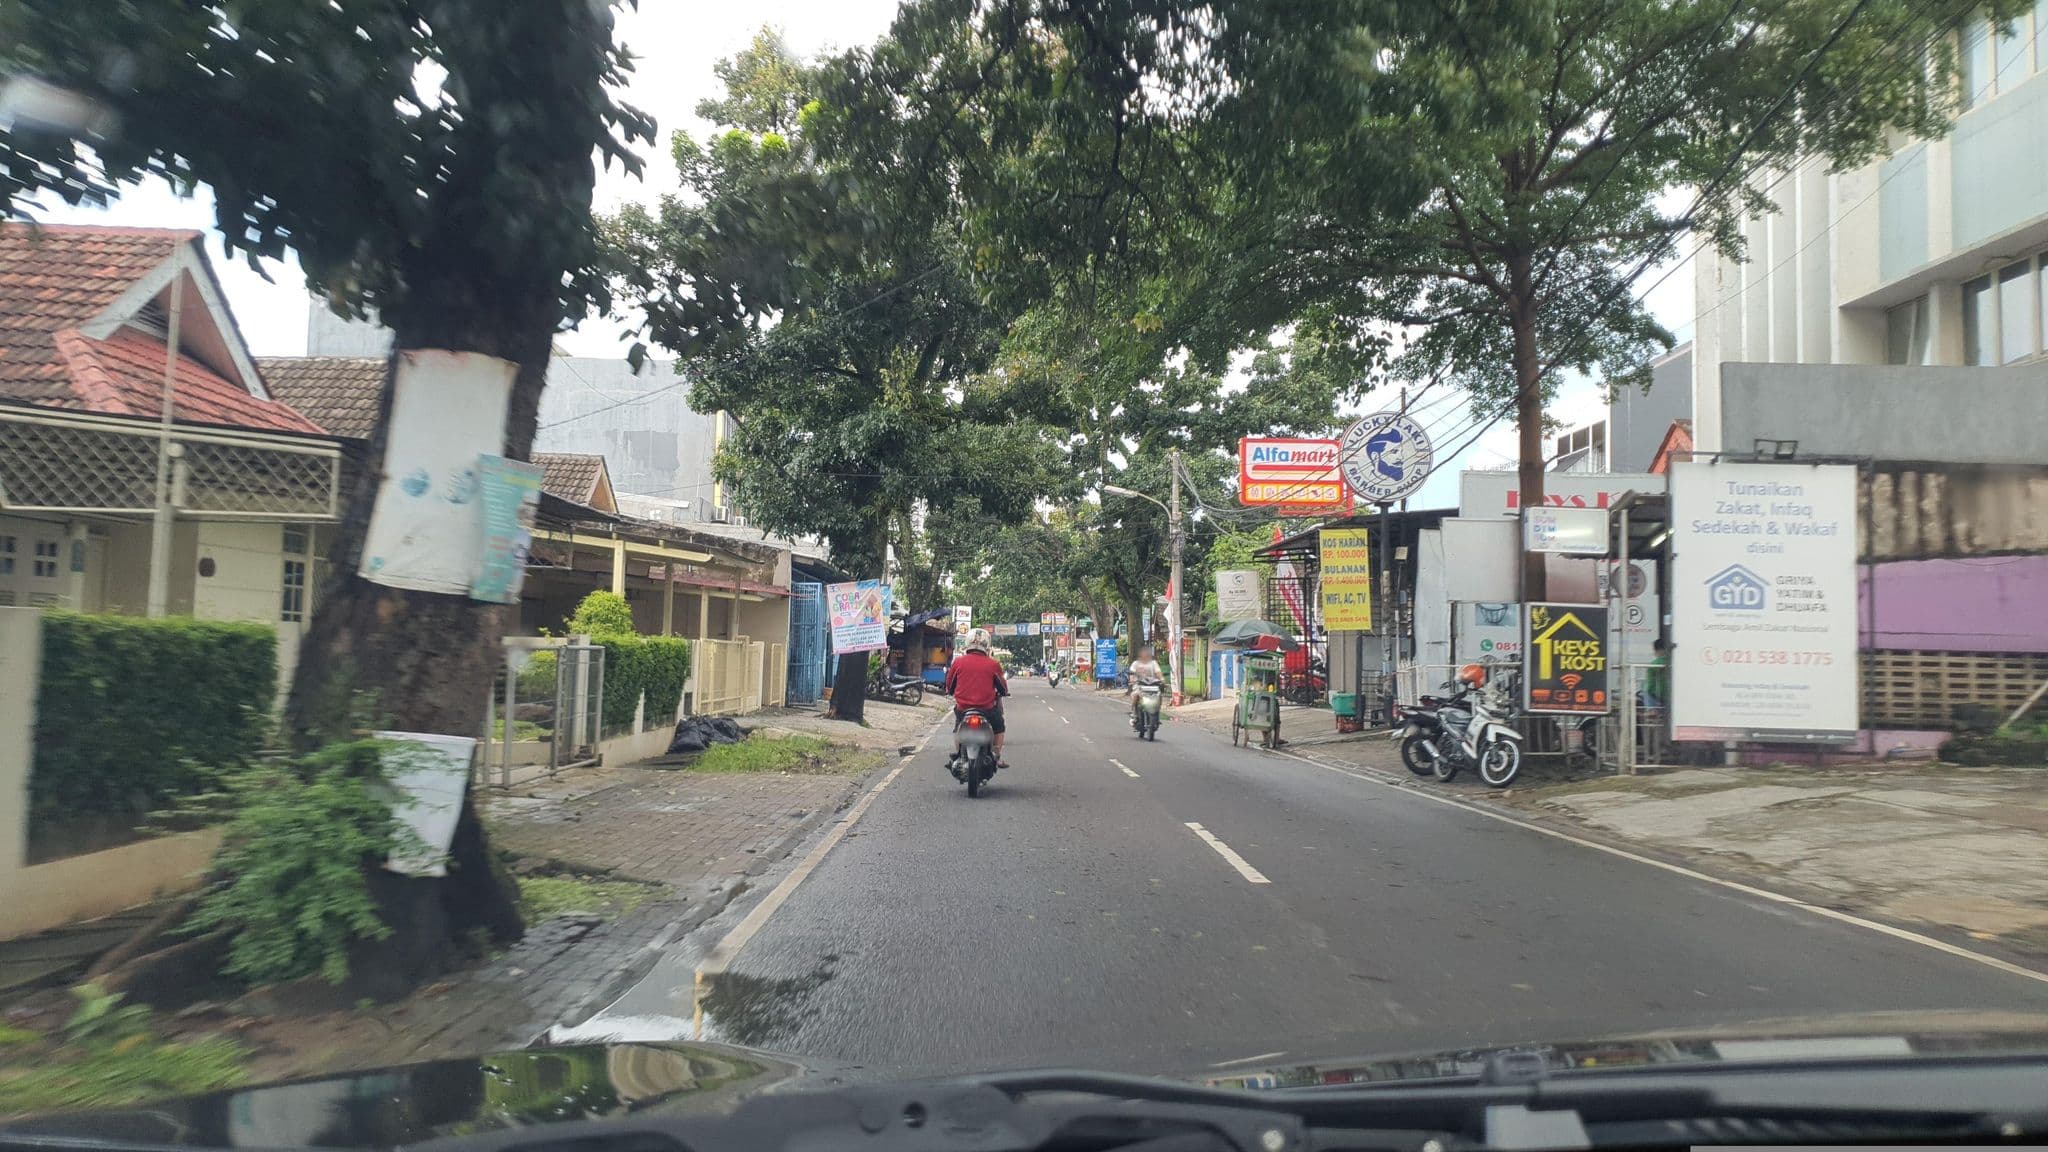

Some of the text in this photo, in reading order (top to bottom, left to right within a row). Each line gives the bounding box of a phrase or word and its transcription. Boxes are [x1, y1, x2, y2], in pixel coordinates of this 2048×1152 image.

[1348, 416, 1425, 446] LUCKY LAKI
[1253, 446, 1337, 463] Alfamart
[1349, 467, 1424, 495] BARBER SHOP
[1726, 481, 1804, 496] Tunaikan
[1715, 501, 1813, 519] Zakat, Infaq
[1692, 520, 1839, 537] Sedekah & Wakaf
[1322, 537, 1366, 549] KOS HARIAN
[1746, 542, 1785, 554] disini
[1775, 575, 1815, 585] GRIYA
[1357, 593, 1366, 604] TV
[1714, 582, 1761, 606] GYD
[1775, 589, 1825, 599] YATIM &
[1775, 602, 1828, 612] DHUAFA
[1553, 640, 1600, 656] KEYS
[1560, 656, 1606, 671] KOST
[1722, 650, 1833, 665] 021 538 1775
